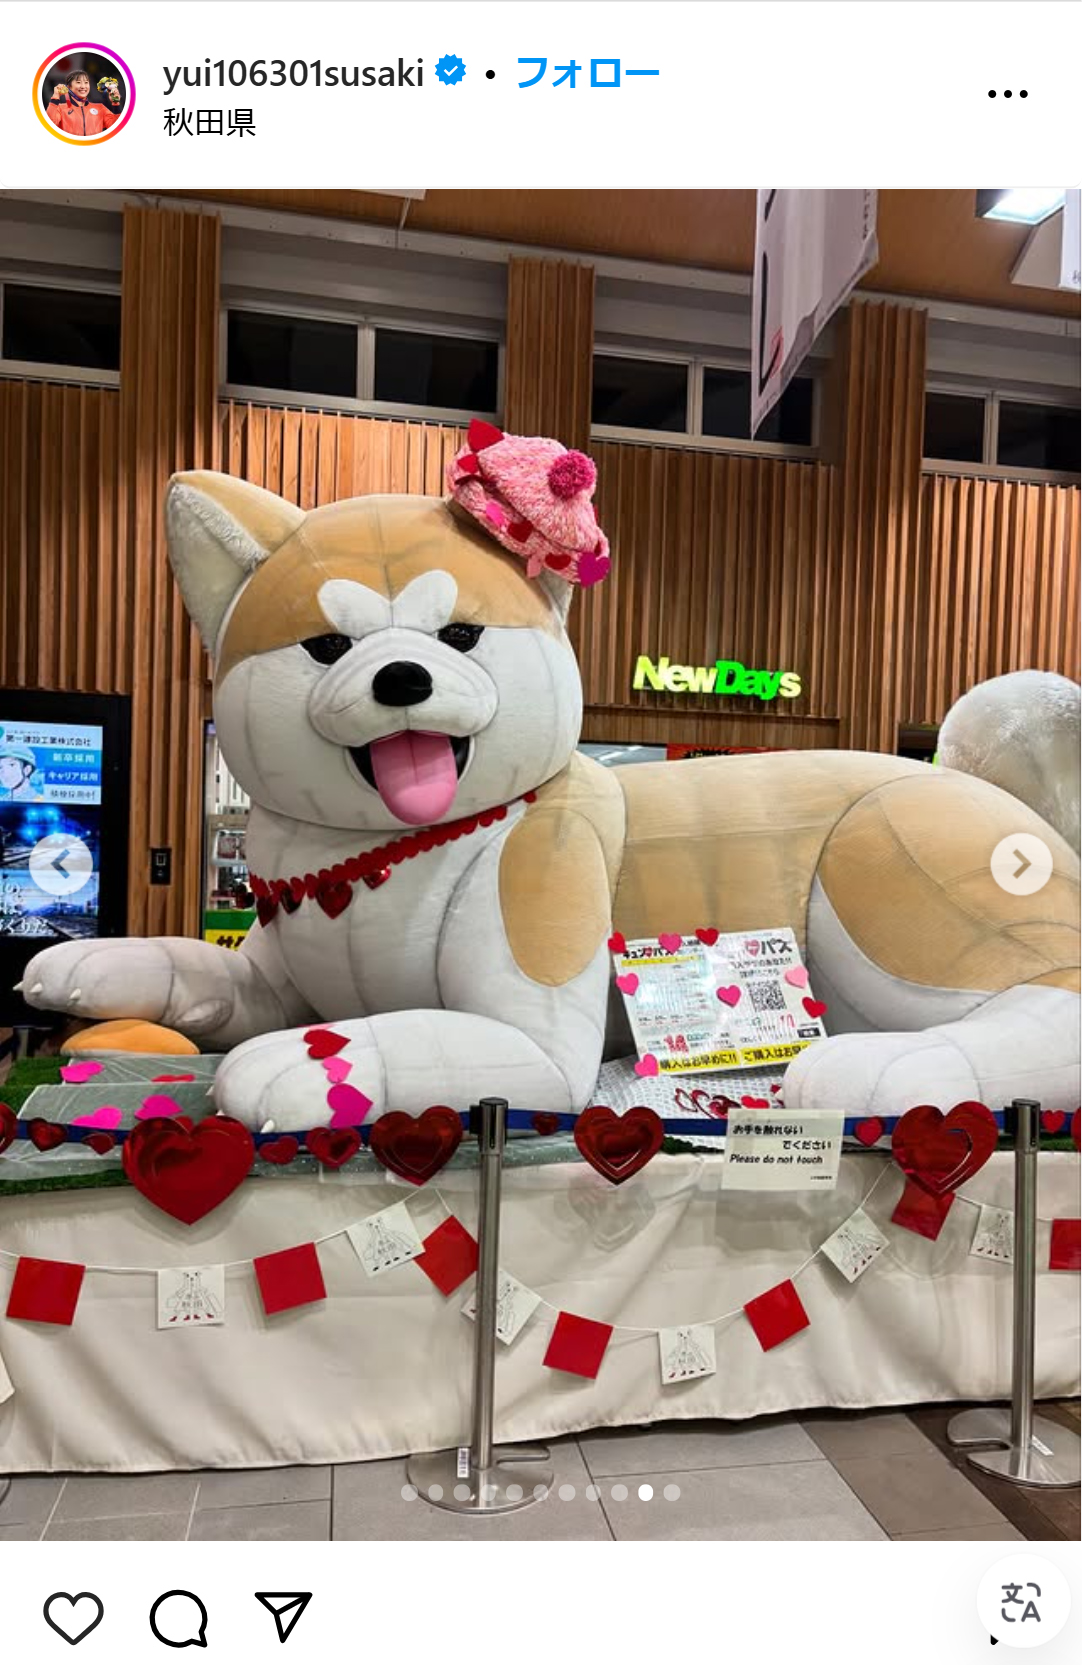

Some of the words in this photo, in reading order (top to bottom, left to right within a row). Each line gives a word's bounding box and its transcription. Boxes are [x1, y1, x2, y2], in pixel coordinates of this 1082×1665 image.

[633, 655, 802, 700] NewDays
[48, 771, 98, 781] キャリア採用
[733, 1125, 803, 1136] お手を触れない
[782, 1140, 831, 1150] でください
[729, 1154, 760, 1164] Please
[763, 1155, 775, 1164] do
[777, 1155, 793, 1164] not
[796, 1155, 823, 1164] touch
